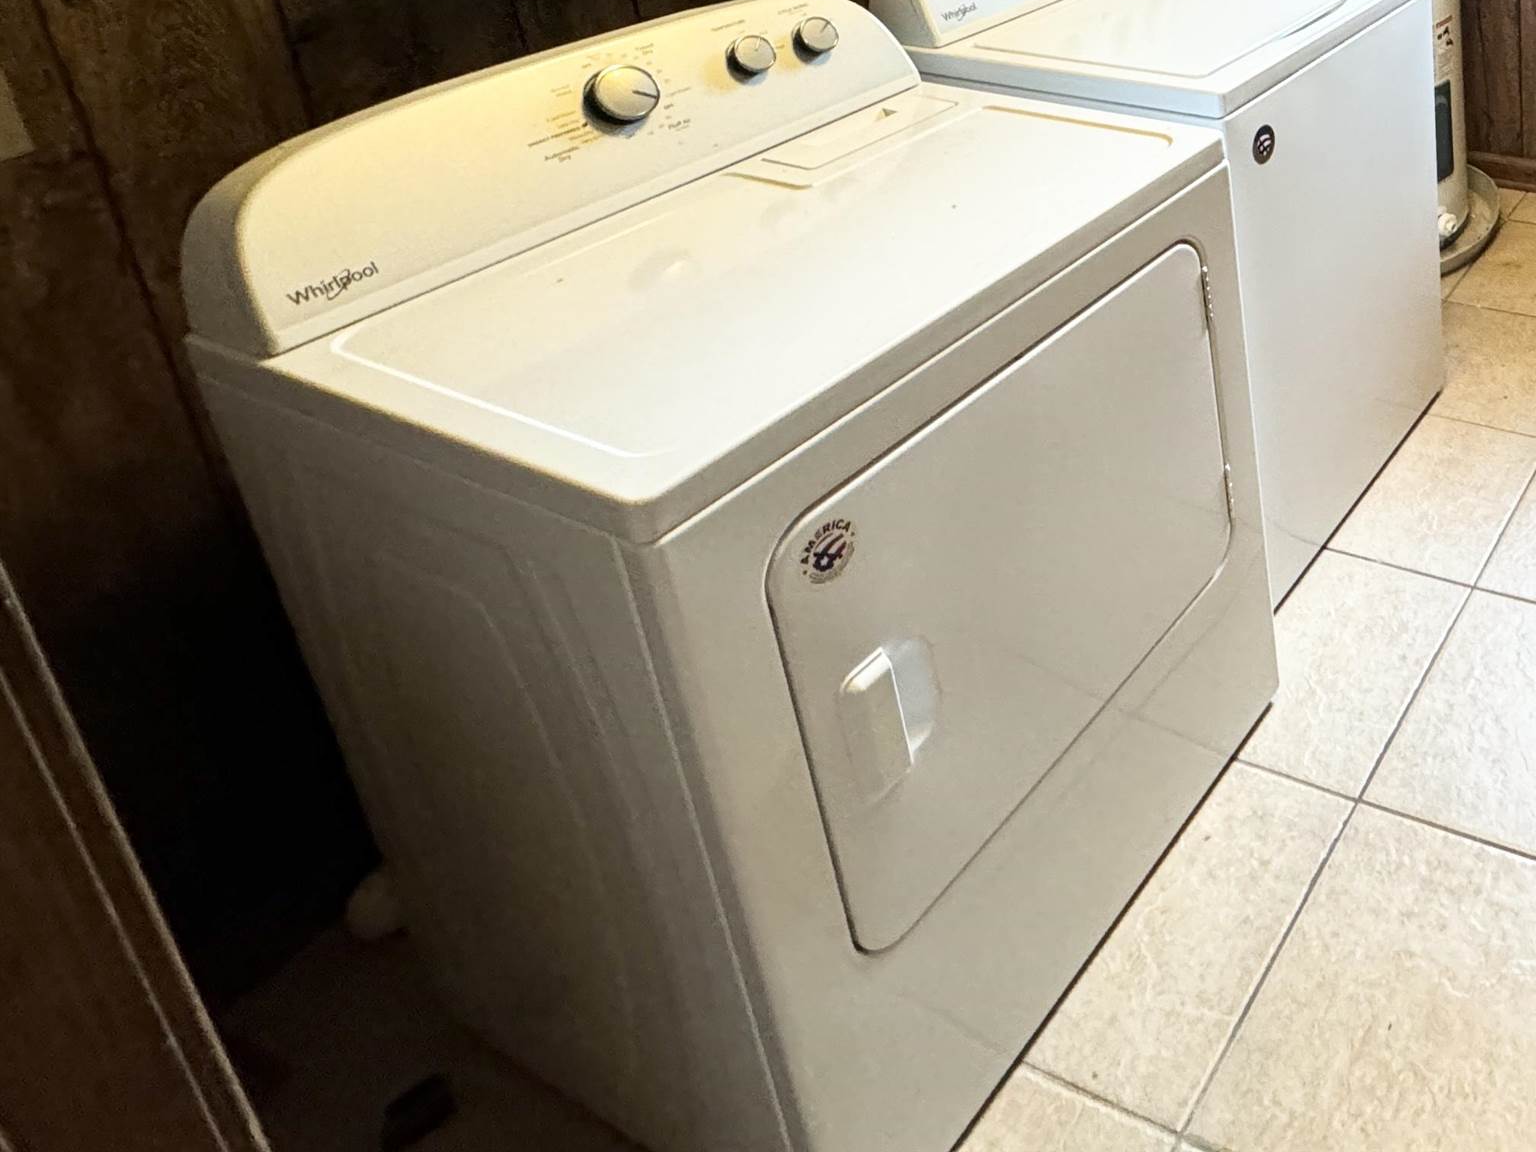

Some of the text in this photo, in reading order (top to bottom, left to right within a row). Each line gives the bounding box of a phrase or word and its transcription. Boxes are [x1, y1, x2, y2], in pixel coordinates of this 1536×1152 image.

[941, 1, 977, 22] Whirlpool
[286, 261, 379, 305] Whirlpool
[801, 519, 851, 565] AMERICA
